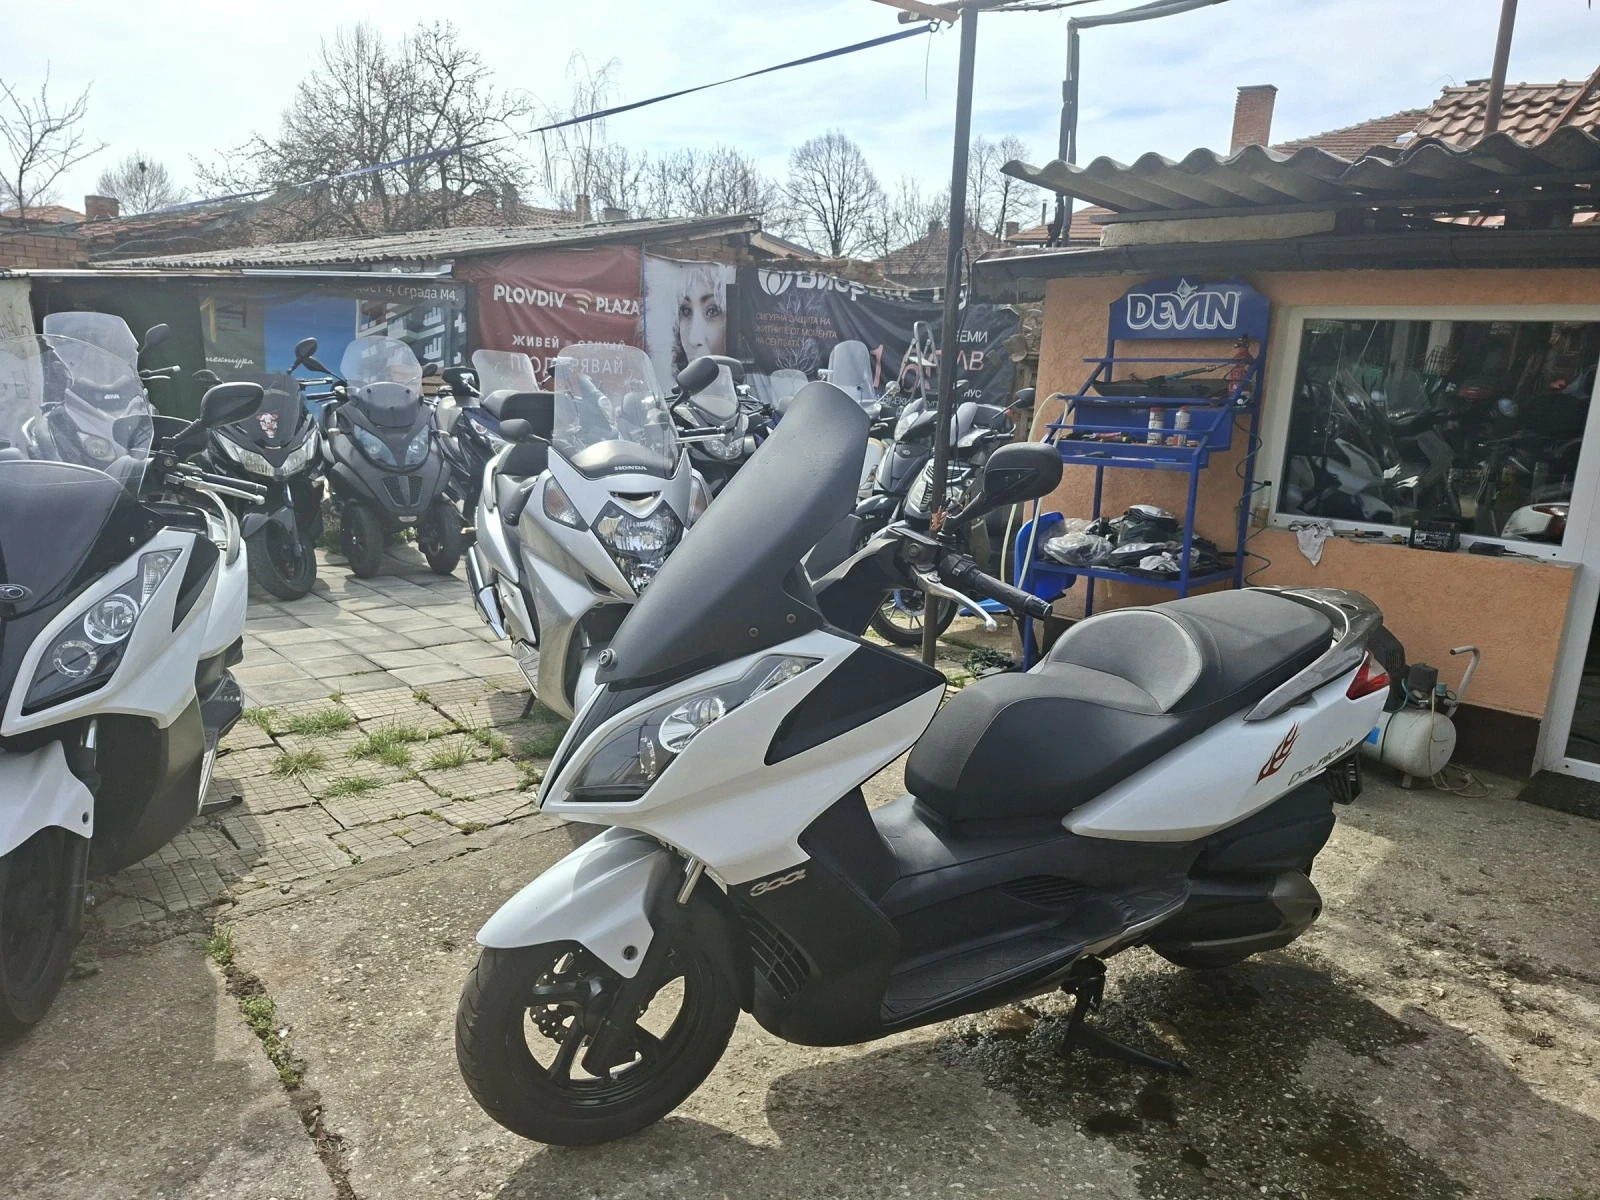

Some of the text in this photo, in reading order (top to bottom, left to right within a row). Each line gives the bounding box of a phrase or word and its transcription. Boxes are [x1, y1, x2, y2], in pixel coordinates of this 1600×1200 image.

[397, 284, 438, 299] Сграда
[493, 284, 641, 316] PLOVDIV PLAZA
[1127, 291, 1240, 330] DEVIN
[820, 317, 831, 326] НА
[512, 334, 560, 349] ЖИВЕЙ
[956, 330, 988, 343] ЕМИ
[509, 353, 624, 376] ПОДРЯВАЙ
[961, 388, 983, 399] НУС
